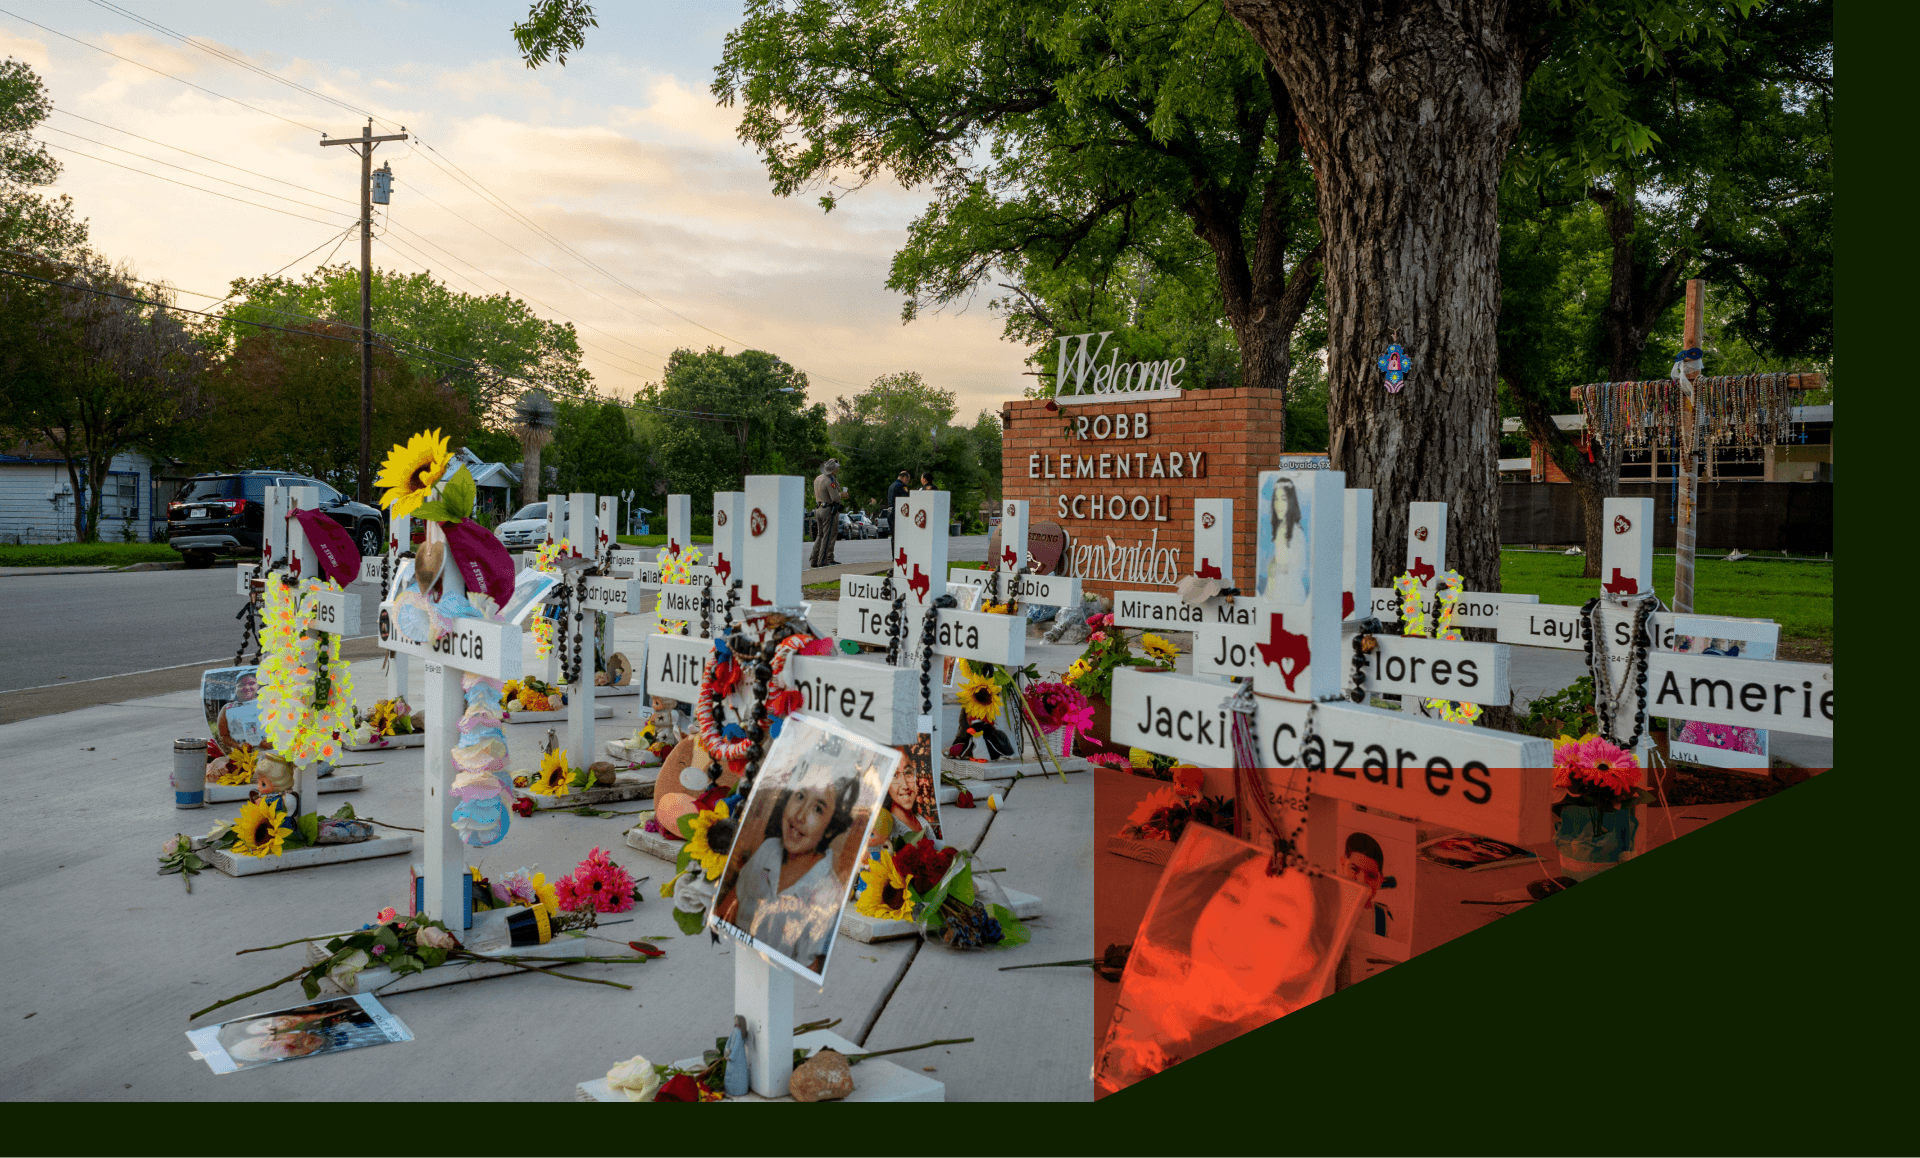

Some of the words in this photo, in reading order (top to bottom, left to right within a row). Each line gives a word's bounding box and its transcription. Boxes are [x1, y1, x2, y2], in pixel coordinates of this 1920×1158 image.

[1055, 331, 1186, 397] Welcome
[1077, 413, 1149, 441] ROBB
[1030, 452, 1202, 479] ELEMENTARY
[1058, 494, 1168, 522] SCHOOL
[1007, 579, 1050, 598] Rubio
[1121, 600, 1203, 623] Miranda
[1530, 616, 1580, 643] Layl
[1362, 650, 1479, 688] lores
[1138, 695, 1226, 749] Jacki
[1273, 723, 1493, 805] Cazares
